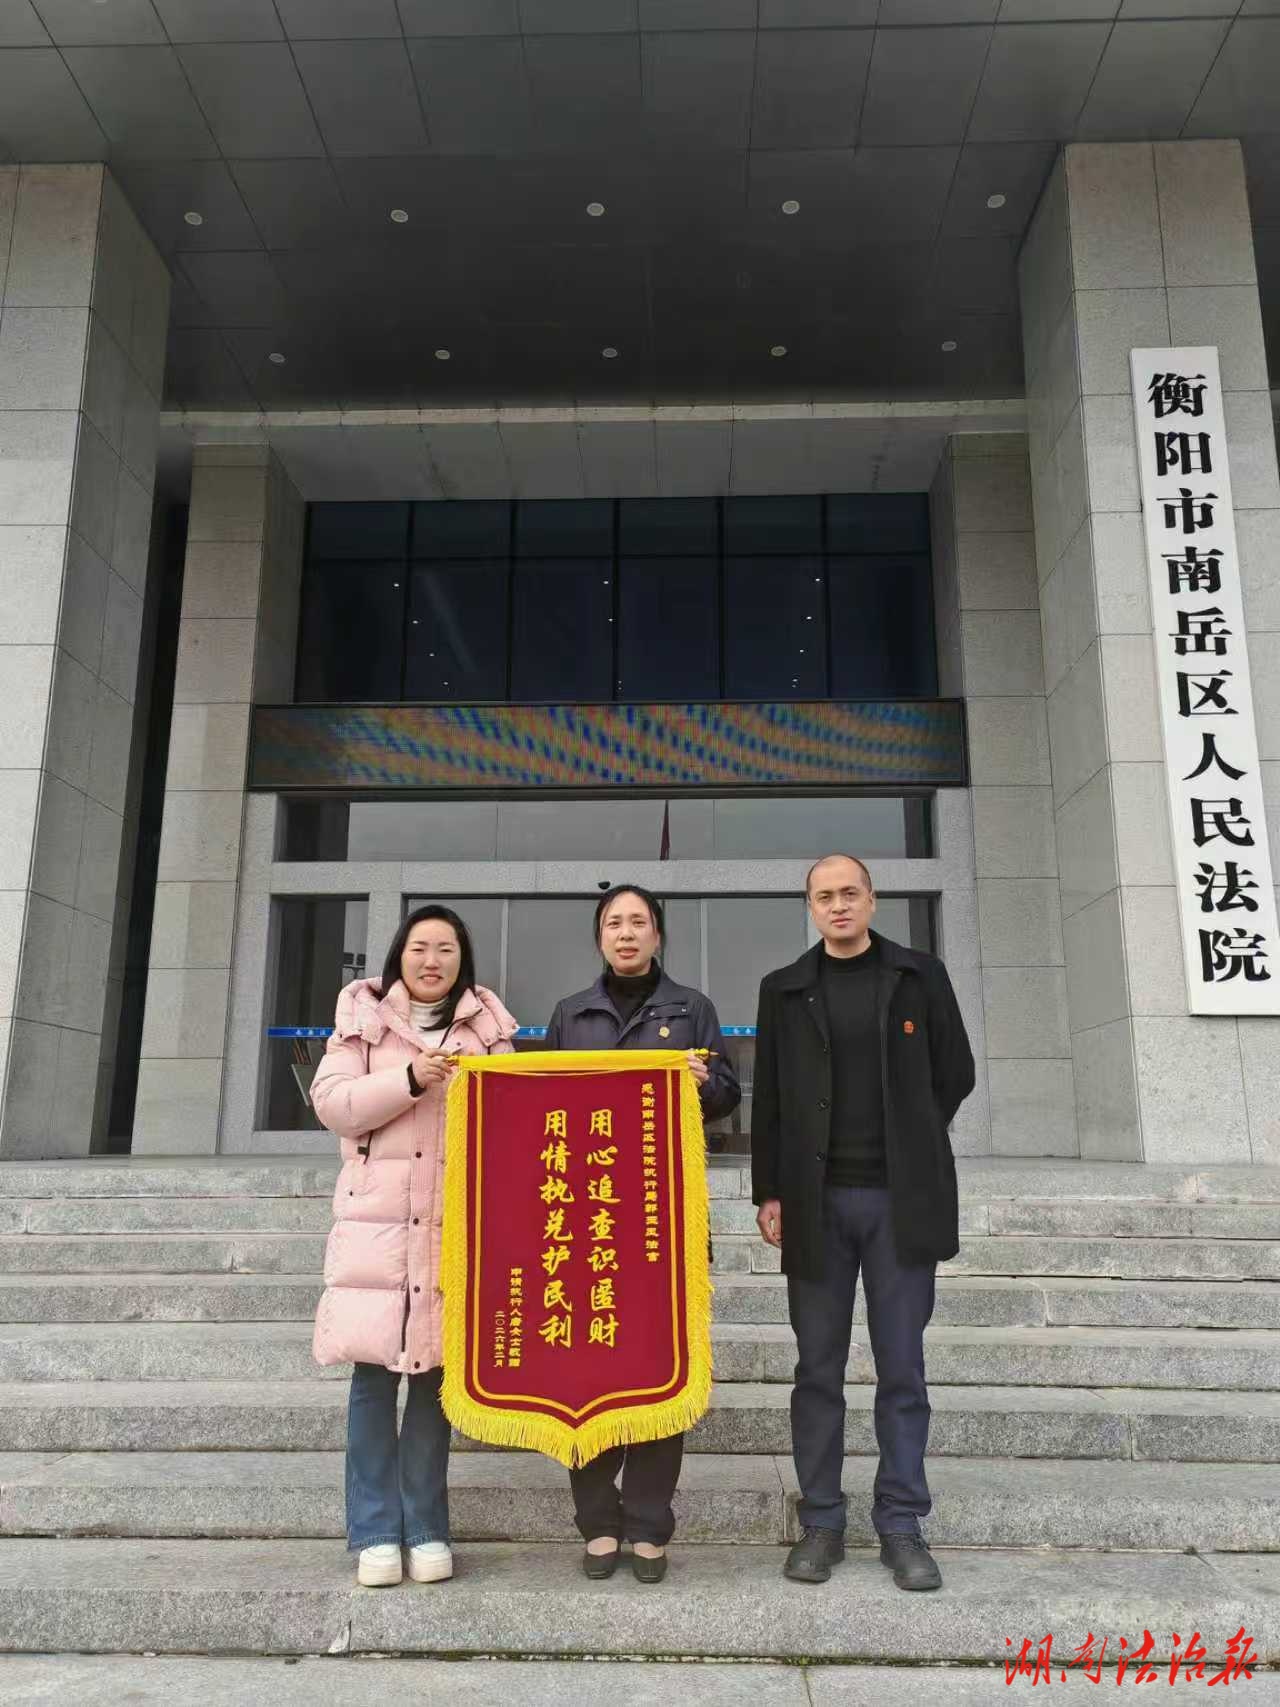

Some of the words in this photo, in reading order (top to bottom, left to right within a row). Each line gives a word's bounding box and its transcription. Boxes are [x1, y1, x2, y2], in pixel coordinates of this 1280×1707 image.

[1147, 372, 1271, 983] 衡阳市南岳区人民法院
[539, 1110, 575, 1348] 用情执兑护民利
[586, 1108, 621, 1348] 用心追查识匿财
